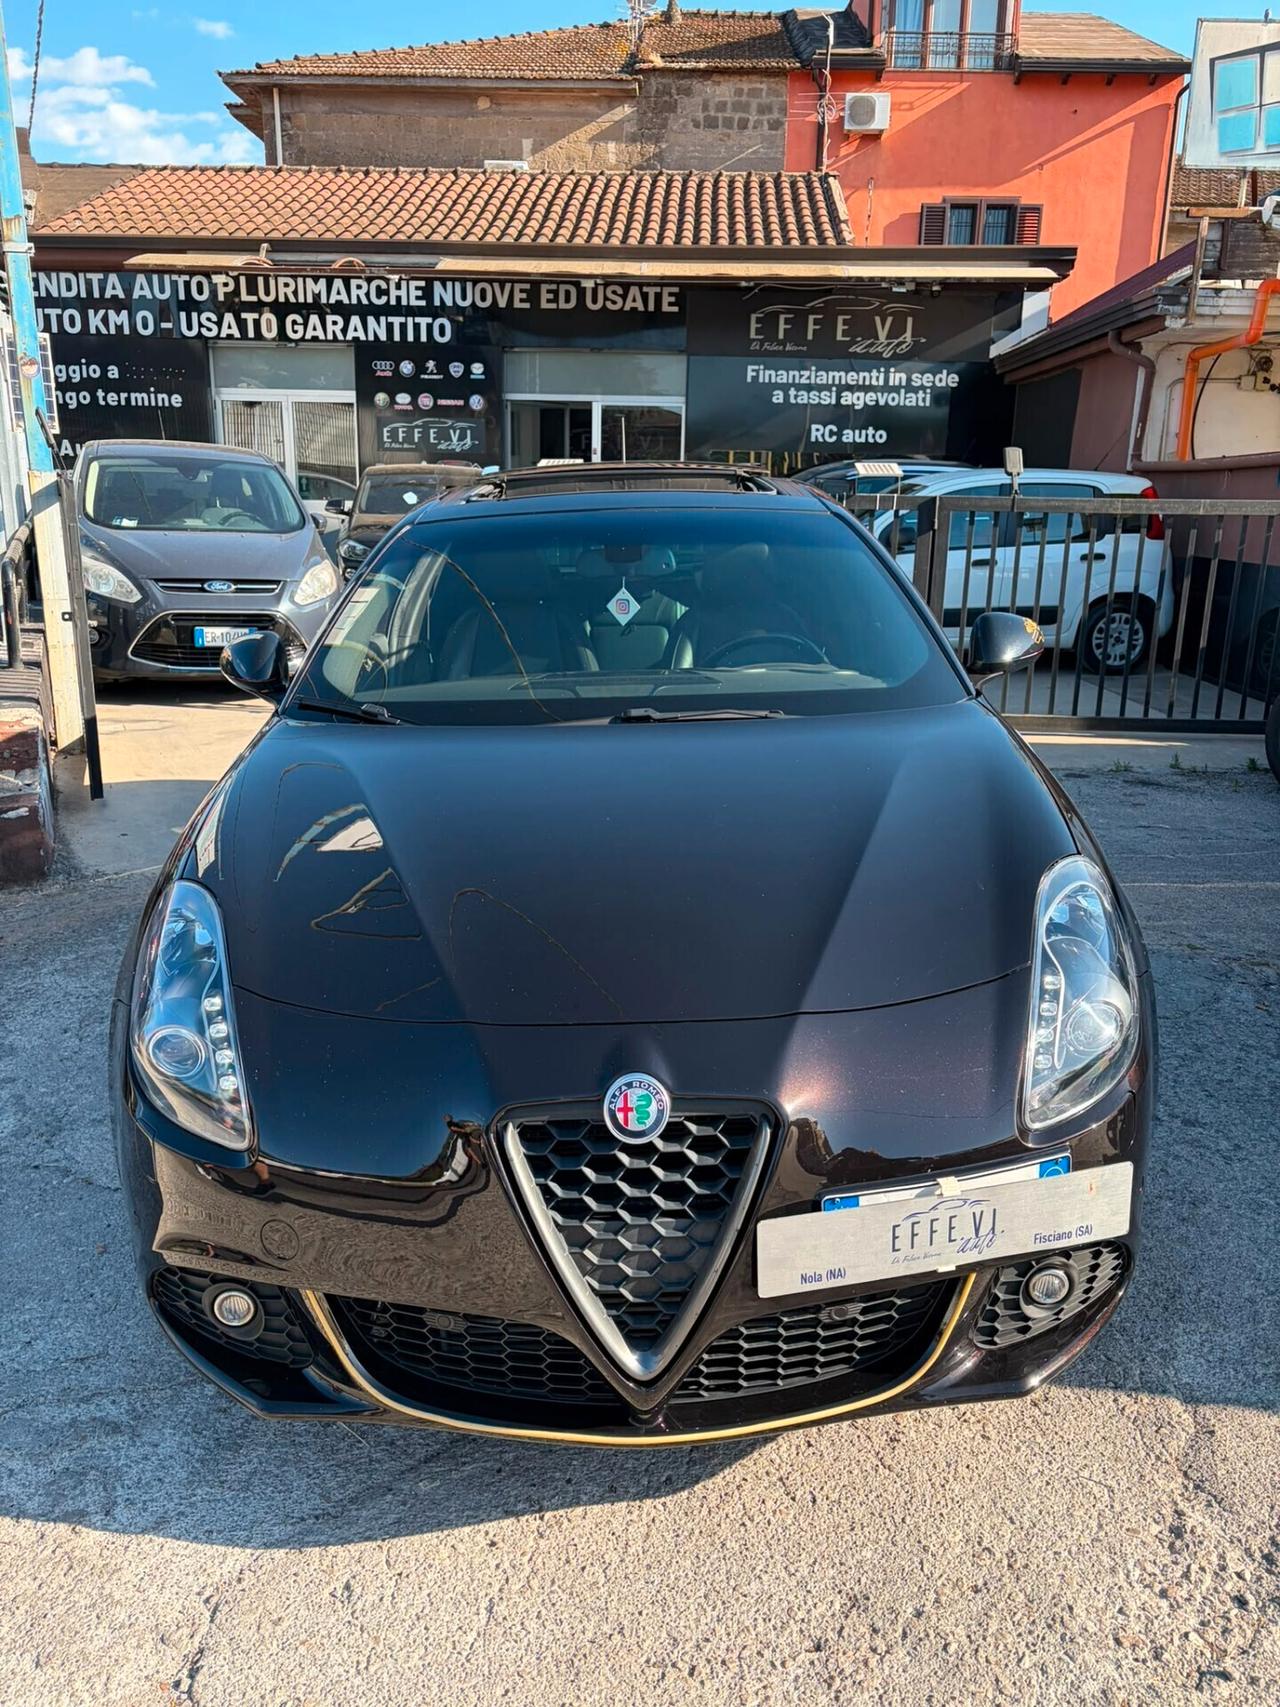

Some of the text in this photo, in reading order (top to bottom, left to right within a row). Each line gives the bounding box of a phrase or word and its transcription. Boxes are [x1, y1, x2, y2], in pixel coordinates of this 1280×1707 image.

[31, 272, 680, 313] ENDITA AUTO PLURIMARCHE NUOVE ED USATE
[37, 308, 82, 335] UTO
[88, 309, 130, 336] KM
[179, 311, 279, 340] USATO
[285, 314, 452, 344] GARANTITO
[107, 364, 120, 379] a
[746, 365, 960, 388] Finanziamenti in sede
[97, 386, 184, 408] termine
[772, 387, 932, 410] a tassi agevolati
[810, 424, 888, 444] RC auto
[609, 1081, 664, 1111] ALFA ROMEO
[1034, 1223, 1093, 1245] Fisciano (SA)
[800, 1267, 847, 1285] Nola (NA)
